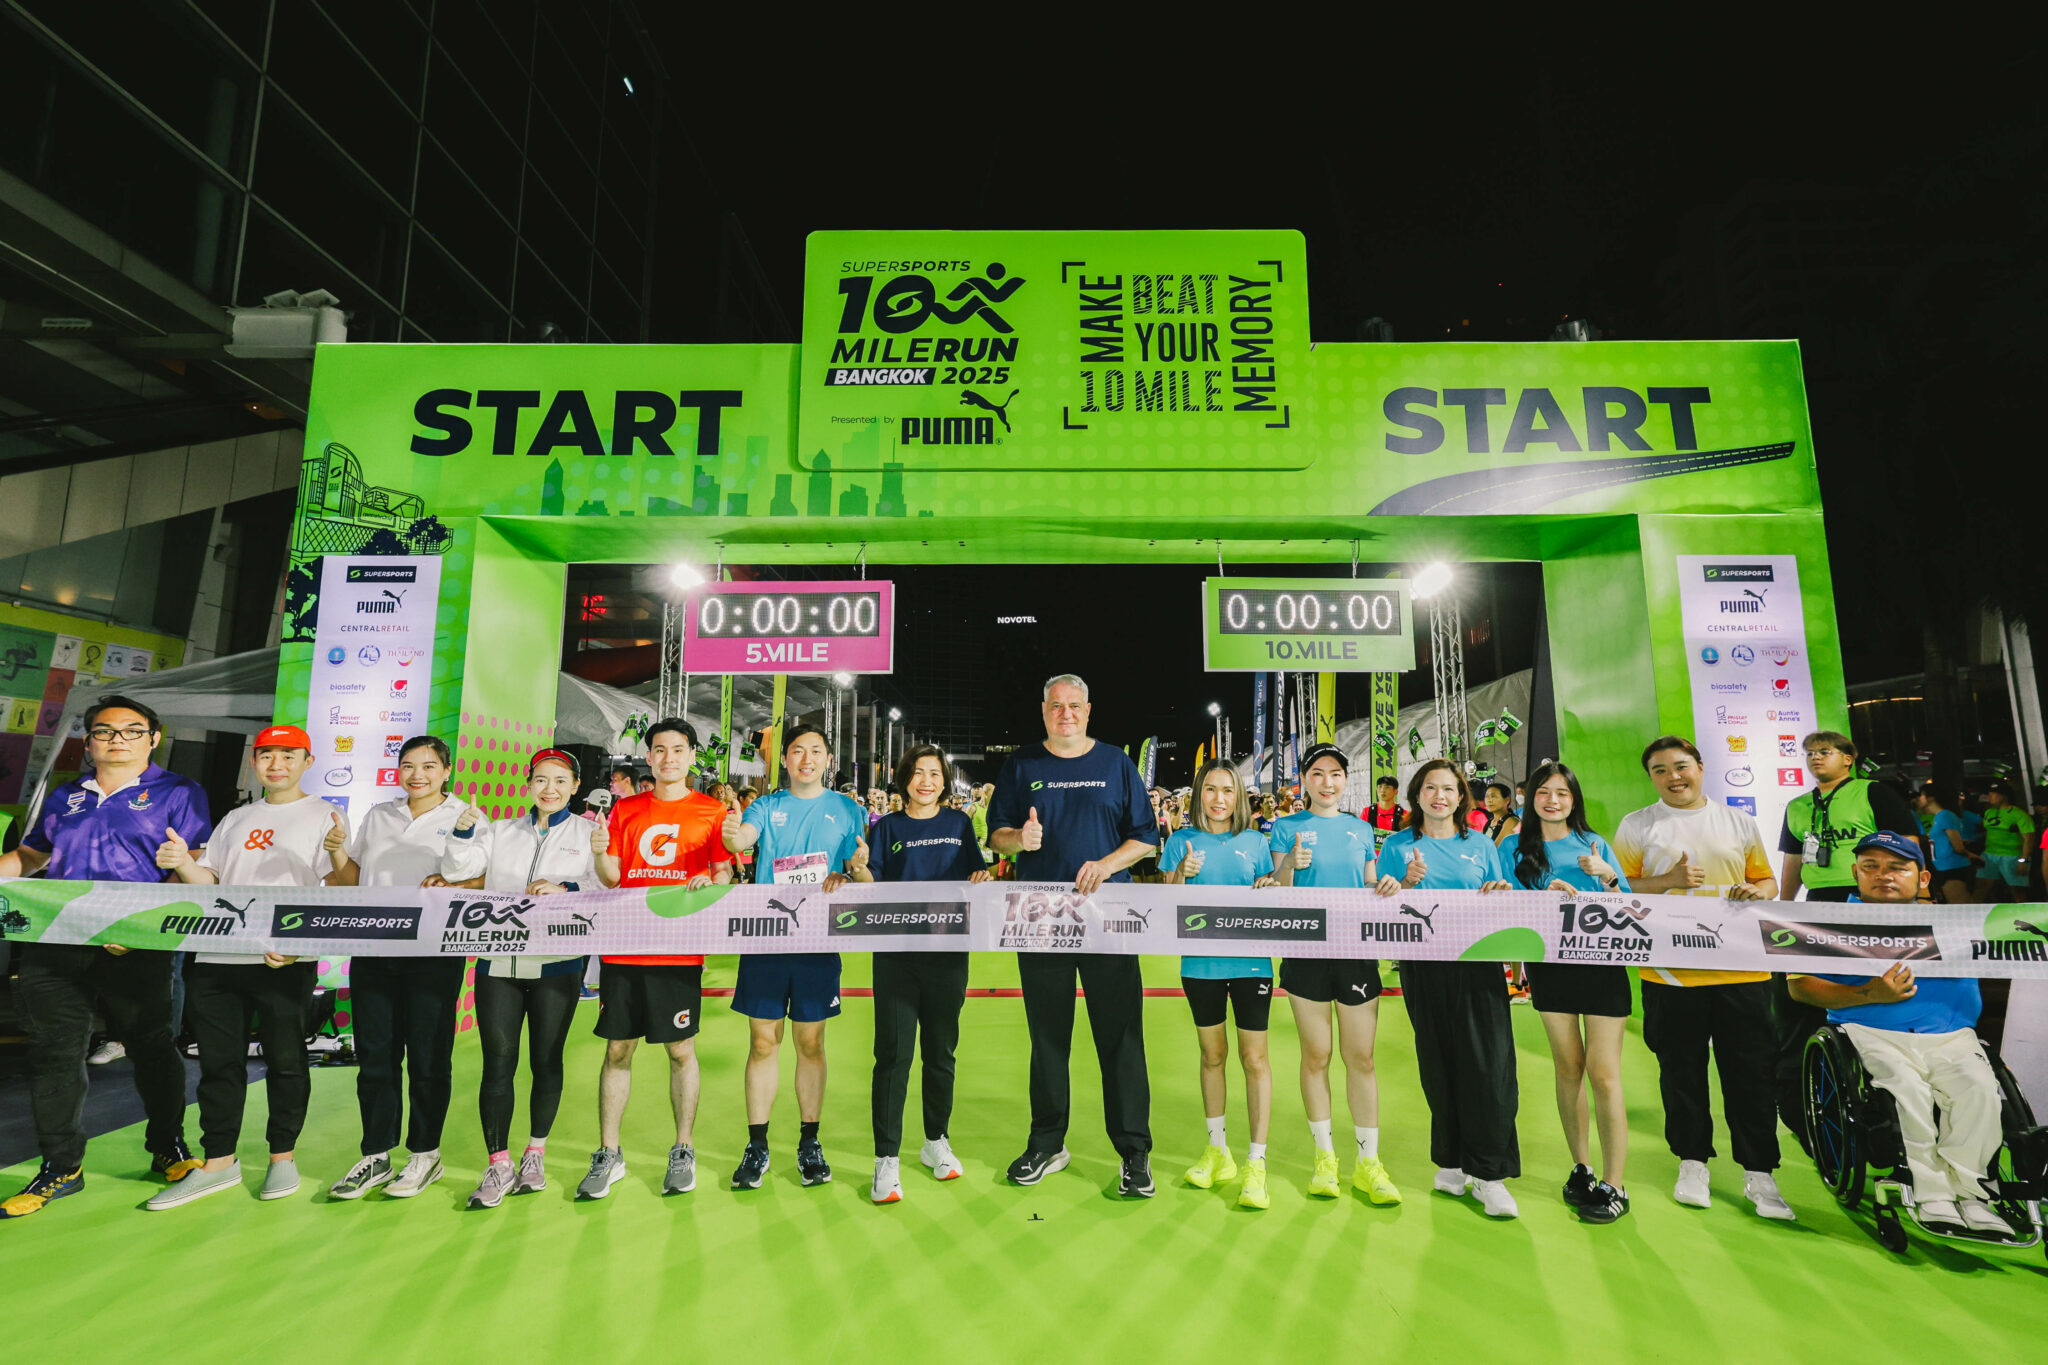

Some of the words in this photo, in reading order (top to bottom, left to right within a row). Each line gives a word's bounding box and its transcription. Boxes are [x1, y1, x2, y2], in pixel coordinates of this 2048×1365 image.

[841, 261, 971, 272] SUPERSPORTS
[1133, 275, 1218, 314] BEAT
[1080, 275, 1124, 362] MAKE
[1135, 323, 1221, 362] YOUR
[1228, 275, 1277, 411] MEMORY
[830, 338, 1019, 363] MILERUN
[834, 368, 928, 385] BANGKOK
[941, 367, 1010, 384] 2025
[1081, 370, 1125, 412] 10
[1135, 370, 1223, 412] MILE
[410, 388, 742, 456] START
[831, 416, 877, 424] Presented
[884, 416, 895, 424] by
[1382, 387, 1711, 455] START
[901, 417, 994, 445] PUMA
[357, 601, 396, 613] PUMA
[1227, 594, 1393, 629] 0:00:00
[1720, 600, 1759, 613] PUMA
[701, 597, 876, 634] 0:00:00
[997, 615, 1037, 624] NOVOTEL
[330, 684, 366, 692] biosafety
[1711, 683, 1747, 691] biosafety
[906, 838, 962, 848] SUPERSPORTS
[627, 868, 688, 881] GATORADE
[788, 872, 817, 885] 7913
[452, 893, 516, 902] SUPERSPORTS
[1559, 895, 1624, 903] SUPERSPORTS
[160, 915, 235, 936] PUMA
[310, 916, 412, 929] SUPERSPORTS
[865, 912, 964, 925] SUPERSPORTS
[1215, 917, 1320, 930] SUPERSPORTS
[547, 923, 587, 937] PUMA
[728, 917, 788, 937] PUMA
[1002, 923, 1086, 938] MILERUN
[1103, 919, 1143, 934] PUMA
[1361, 922, 1423, 942] PUMA
[443, 930, 530, 943] MILERUN
[1004, 938, 1046, 947] BANGKOK
[1051, 939, 1083, 948] 2025
[1559, 936, 1653, 951] MILERUN
[1672, 933, 1717, 949] PUMA
[1806, 933, 1928, 949] SUPERSPORTS
[444, 944, 489, 952] BANGKOK
[494, 943, 526, 952] 2025
[1970, 940, 2048, 960] PUMA
[1561, 951, 1610, 960] BANGKOK
[1615, 951, 1651, 962] 2025
